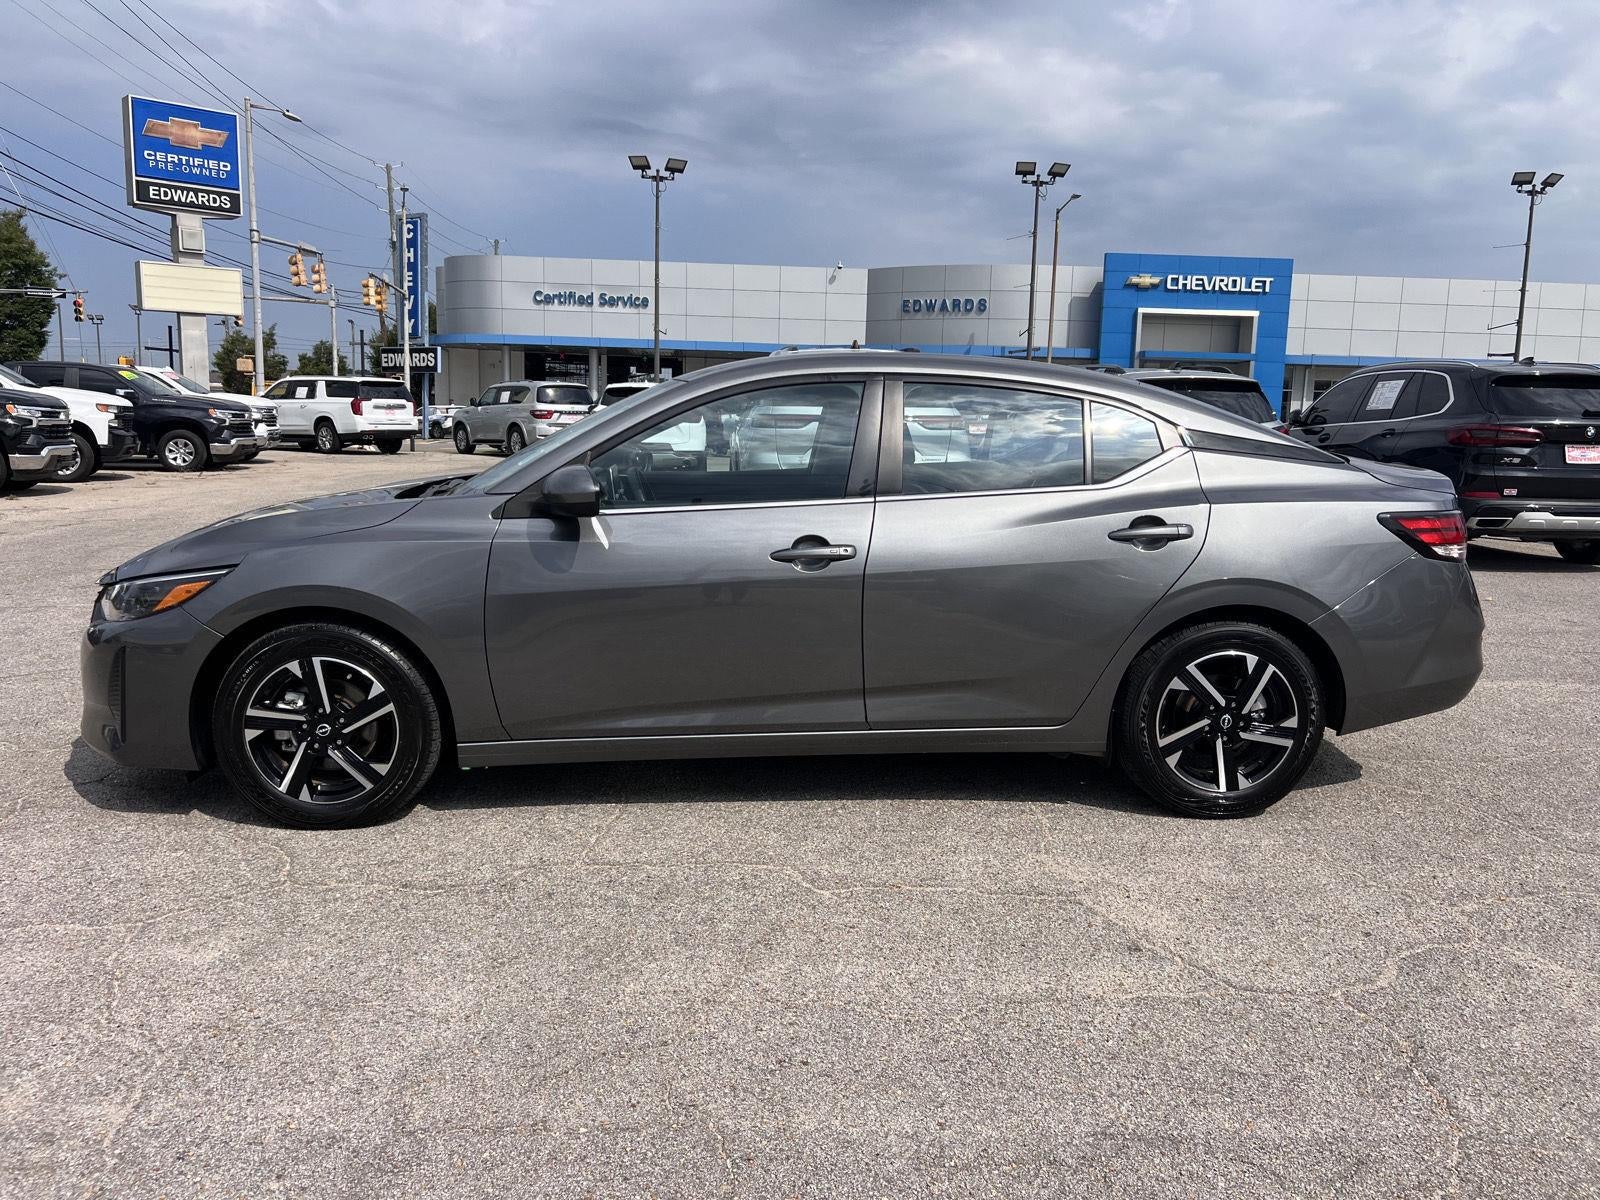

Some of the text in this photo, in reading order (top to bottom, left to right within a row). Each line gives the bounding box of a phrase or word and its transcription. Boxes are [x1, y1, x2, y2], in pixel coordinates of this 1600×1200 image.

[143, 150, 231, 171] CERTIFIED
[149, 161, 227, 179] PRE-OWNED
[149, 186, 231, 208] EDWARDS
[404, 223, 416, 334] CHEVY
[1166, 274, 1274, 293] CHEVROLET
[533, 290, 650, 308] Certified Service
[902, 298, 988, 313] EDWARDS
